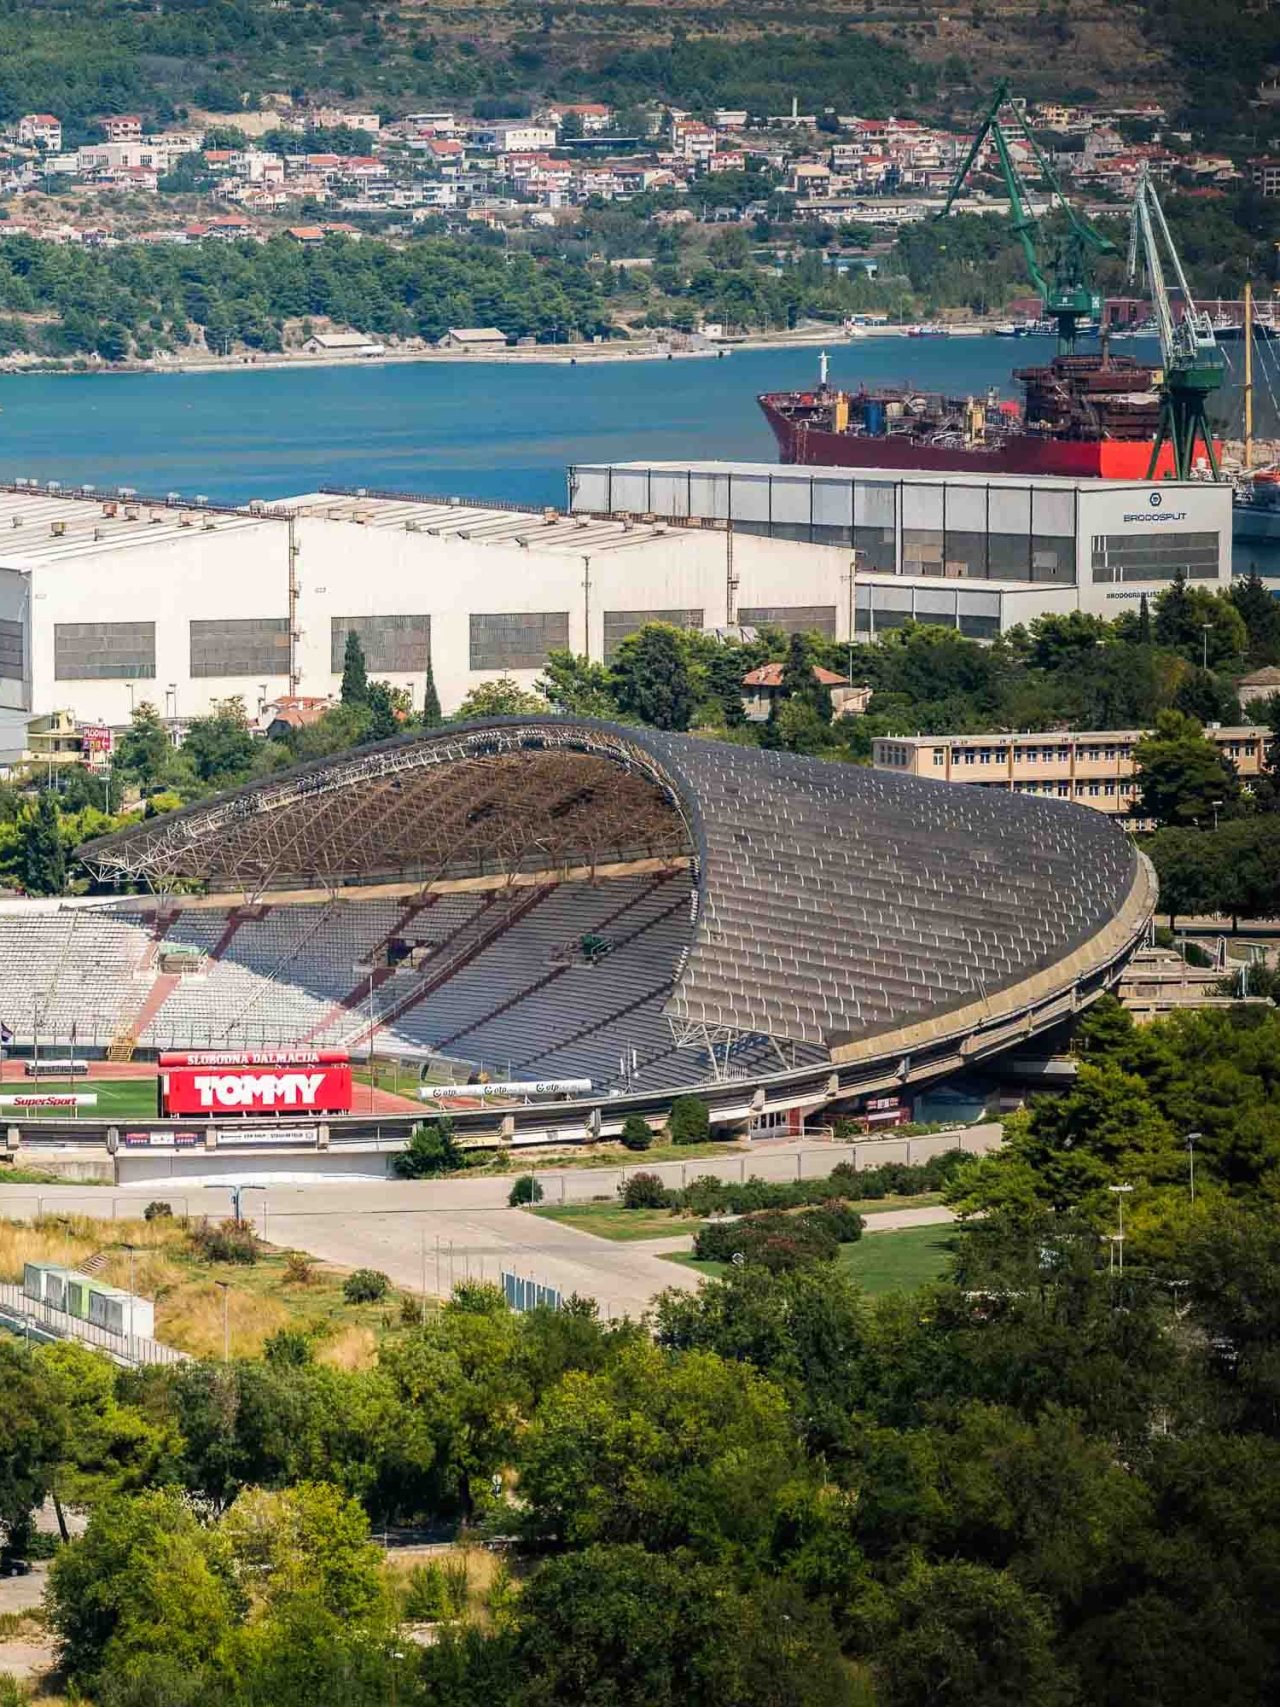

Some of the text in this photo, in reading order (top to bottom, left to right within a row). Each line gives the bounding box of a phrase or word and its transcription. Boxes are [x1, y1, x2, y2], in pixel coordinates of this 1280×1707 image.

[187, 1052, 319, 1066] SLOBODNA DALMACIJA
[194, 1073, 326, 1106] TOMMY
[13, 1096, 77, 1106] SuperSport
